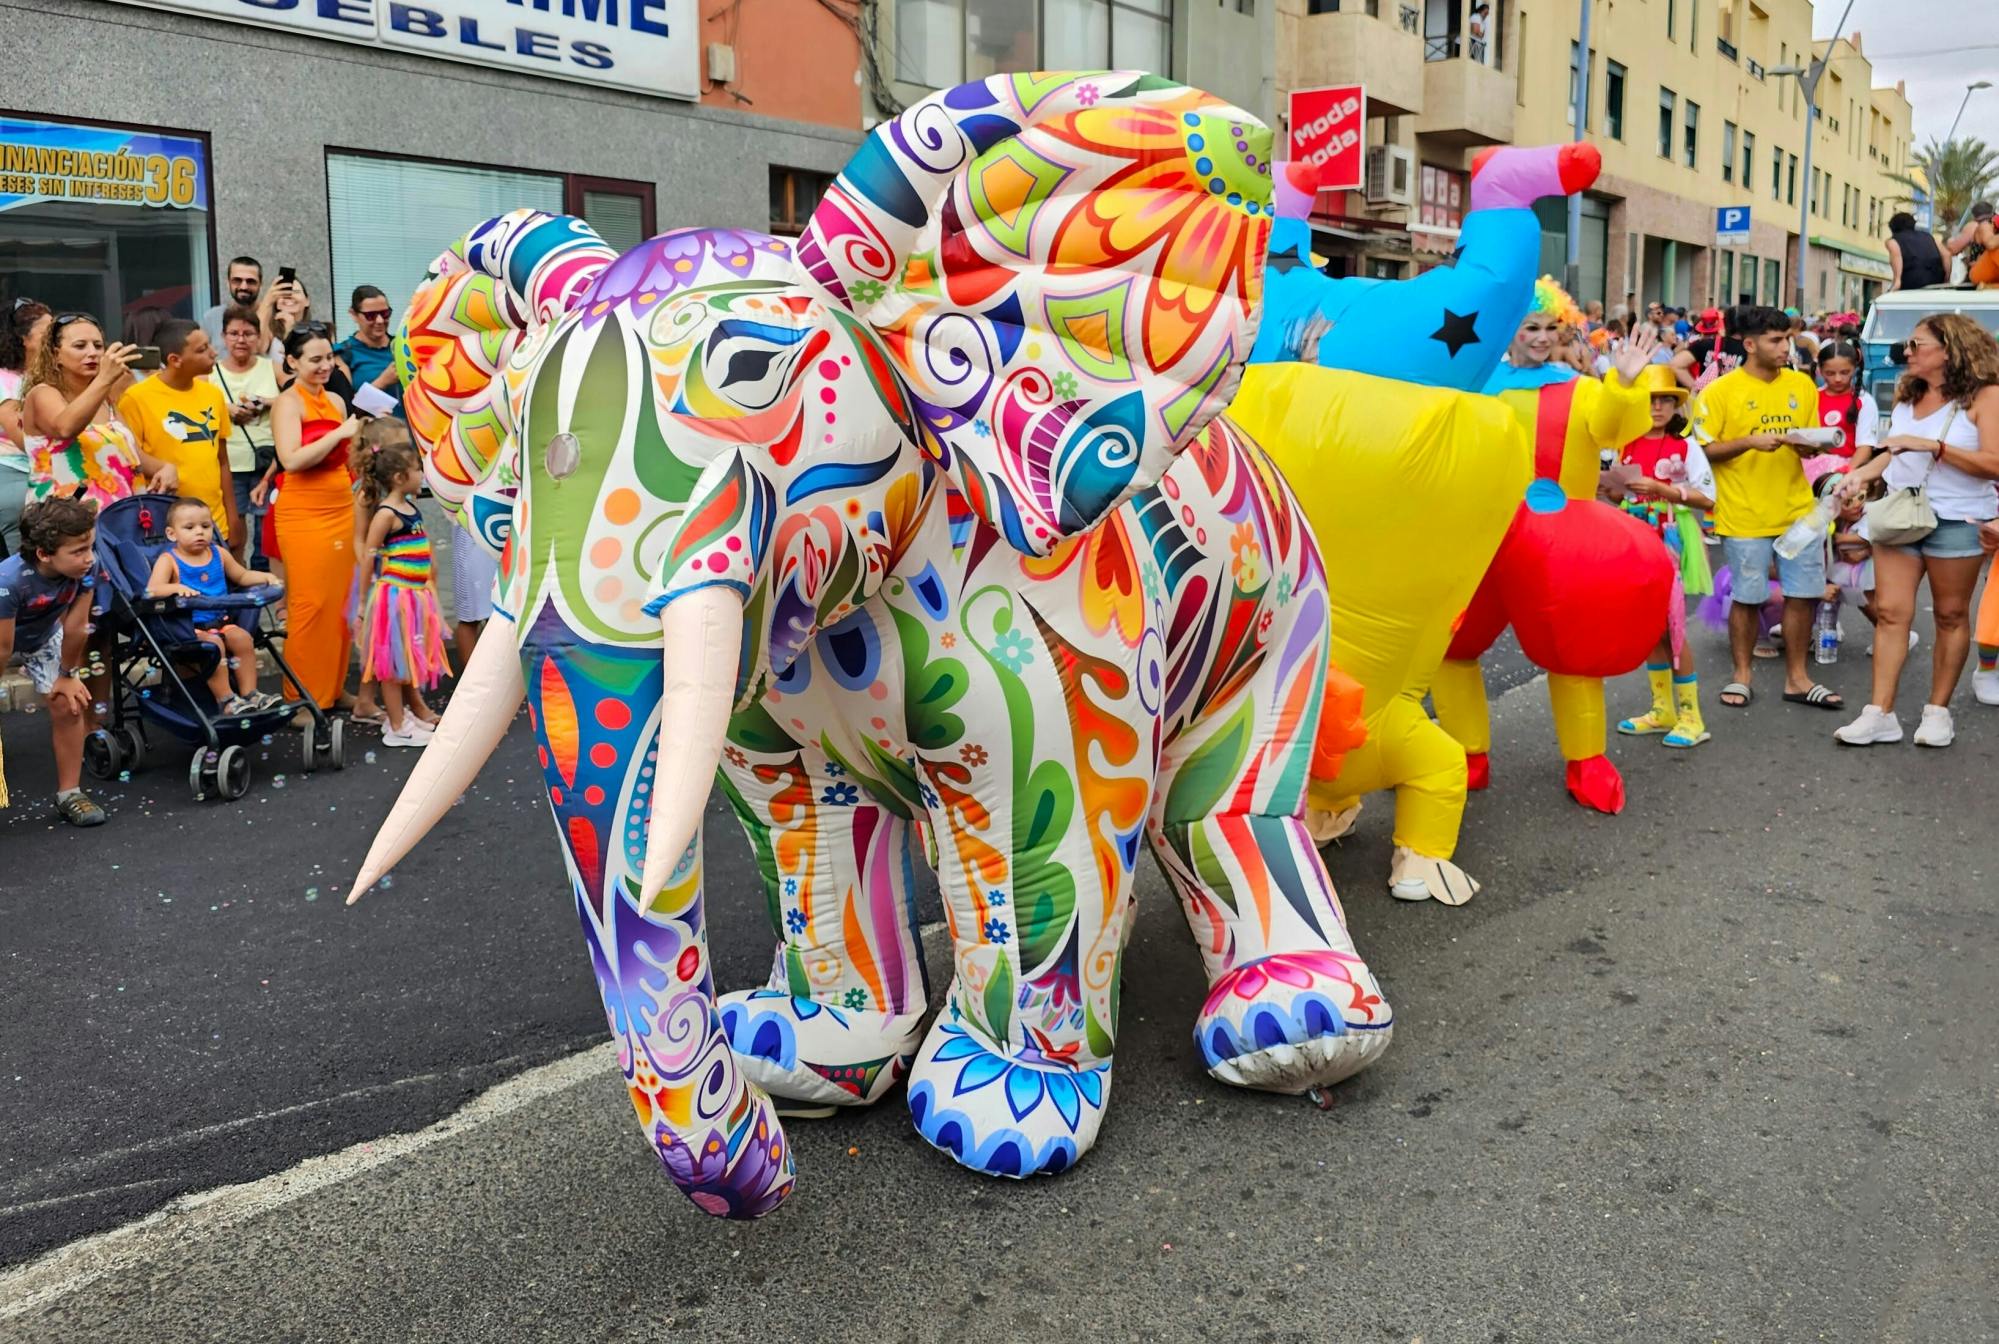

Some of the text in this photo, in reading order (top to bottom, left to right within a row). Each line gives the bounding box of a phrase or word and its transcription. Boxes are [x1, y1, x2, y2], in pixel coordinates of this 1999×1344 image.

[1294, 96, 1359, 148] Moda
[38, 177, 66, 198] SIN
[70, 179, 144, 201] INTERESES
[145, 155, 197, 205] 36
[1725, 209, 1742, 229] P
